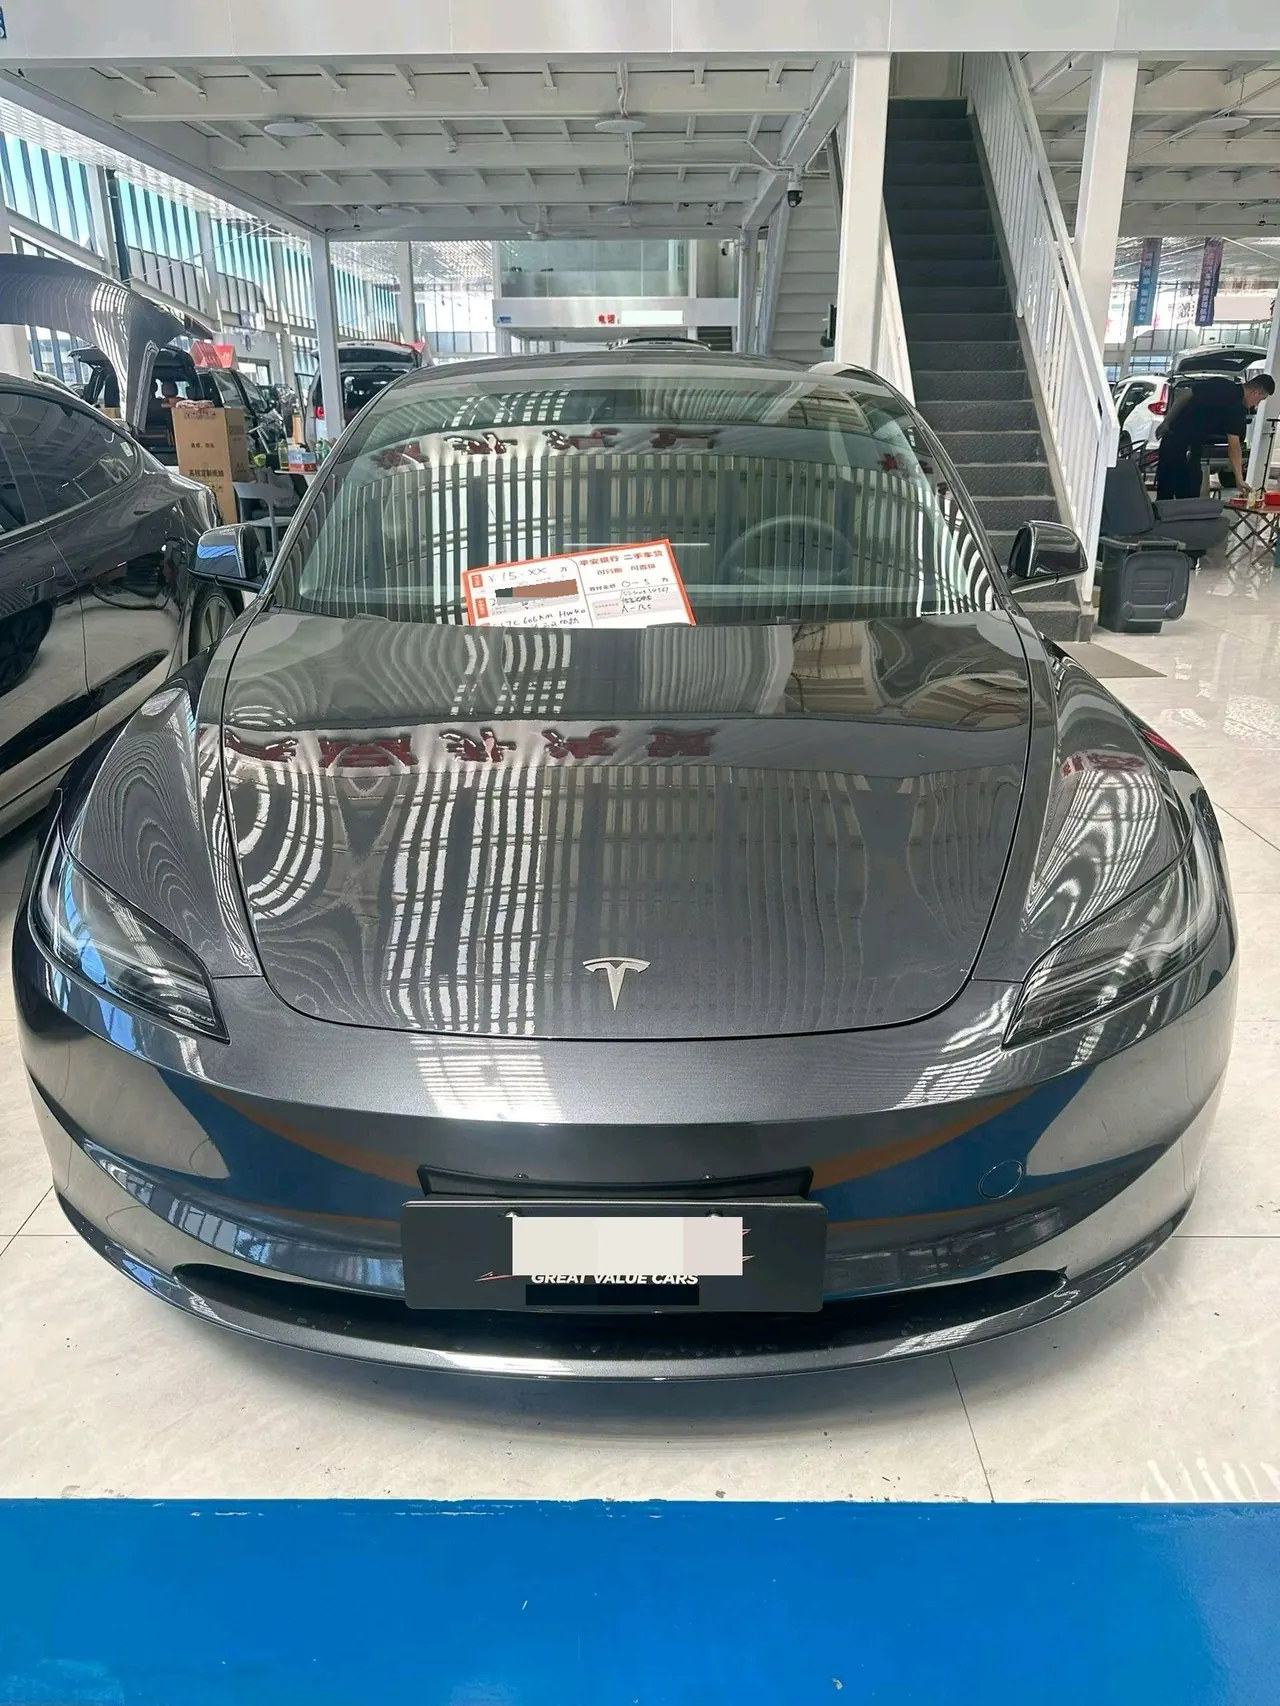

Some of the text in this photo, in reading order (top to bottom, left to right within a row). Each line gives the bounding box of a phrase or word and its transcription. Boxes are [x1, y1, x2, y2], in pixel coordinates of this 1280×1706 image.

[580, 555, 619, 566] 平安银行
[531, 1275, 699, 1285] GREAT VALUE CARS
